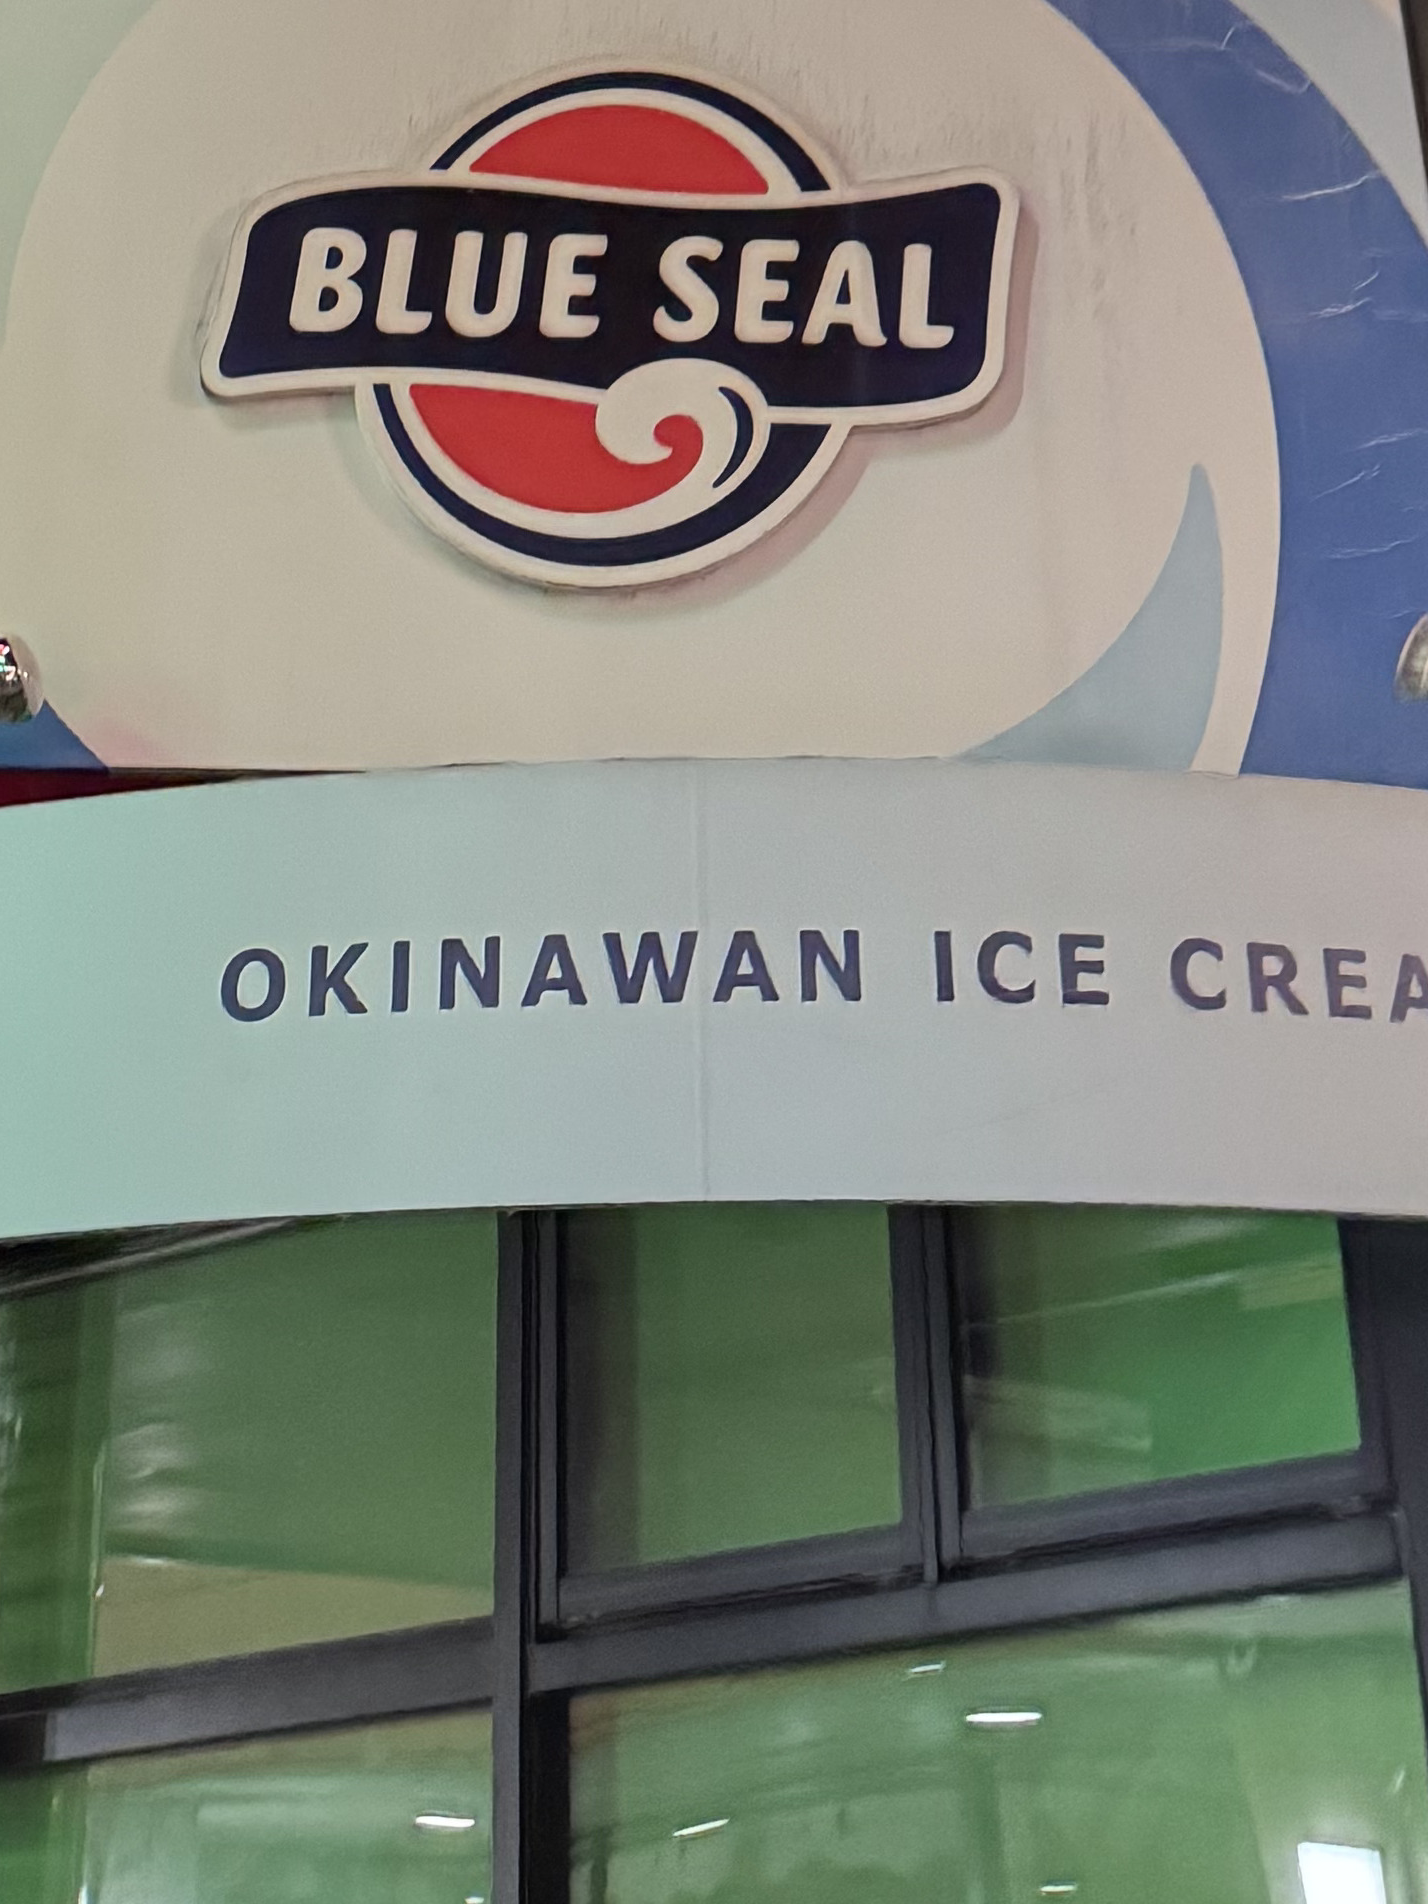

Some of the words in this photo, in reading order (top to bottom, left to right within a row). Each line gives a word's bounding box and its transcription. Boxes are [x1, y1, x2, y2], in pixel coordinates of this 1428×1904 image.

[288, 226, 609, 339] BLUE
[653, 235, 954, 349] SEAL
[219, 929, 864, 1023] OKINAWAN
[932, 930, 1113, 1007] ICE
